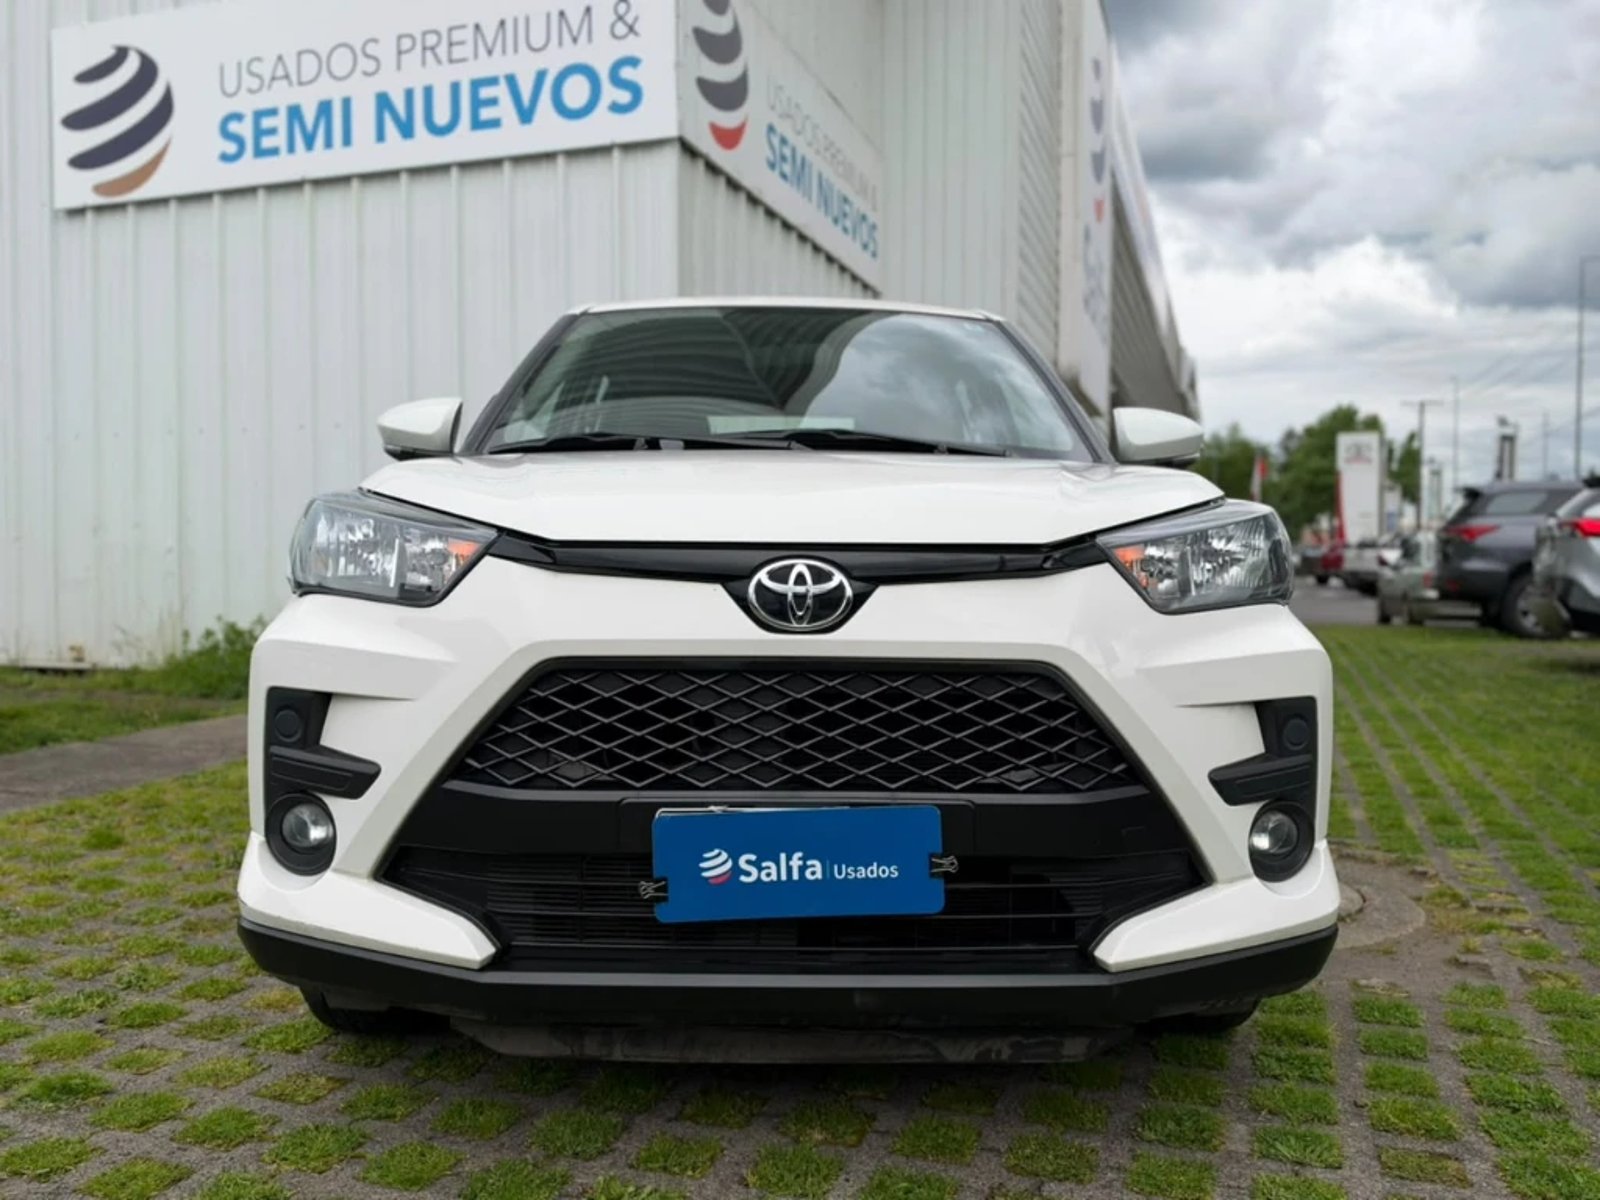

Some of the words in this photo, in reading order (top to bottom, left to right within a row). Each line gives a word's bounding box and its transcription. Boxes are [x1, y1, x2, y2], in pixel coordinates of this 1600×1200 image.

[219, 37, 382, 98] USADOS
[396, 5, 594, 72] PREMIUM
[609, 0, 641, 41] &
[218, 96, 354, 165] SEMI
[374, 55, 645, 144] NUEVOS
[765, 121, 813, 204] SEMI
[816, 169, 878, 260] NUEVOS
[738, 851, 823, 883] Salfa
[833, 862, 899, 880] Usados
